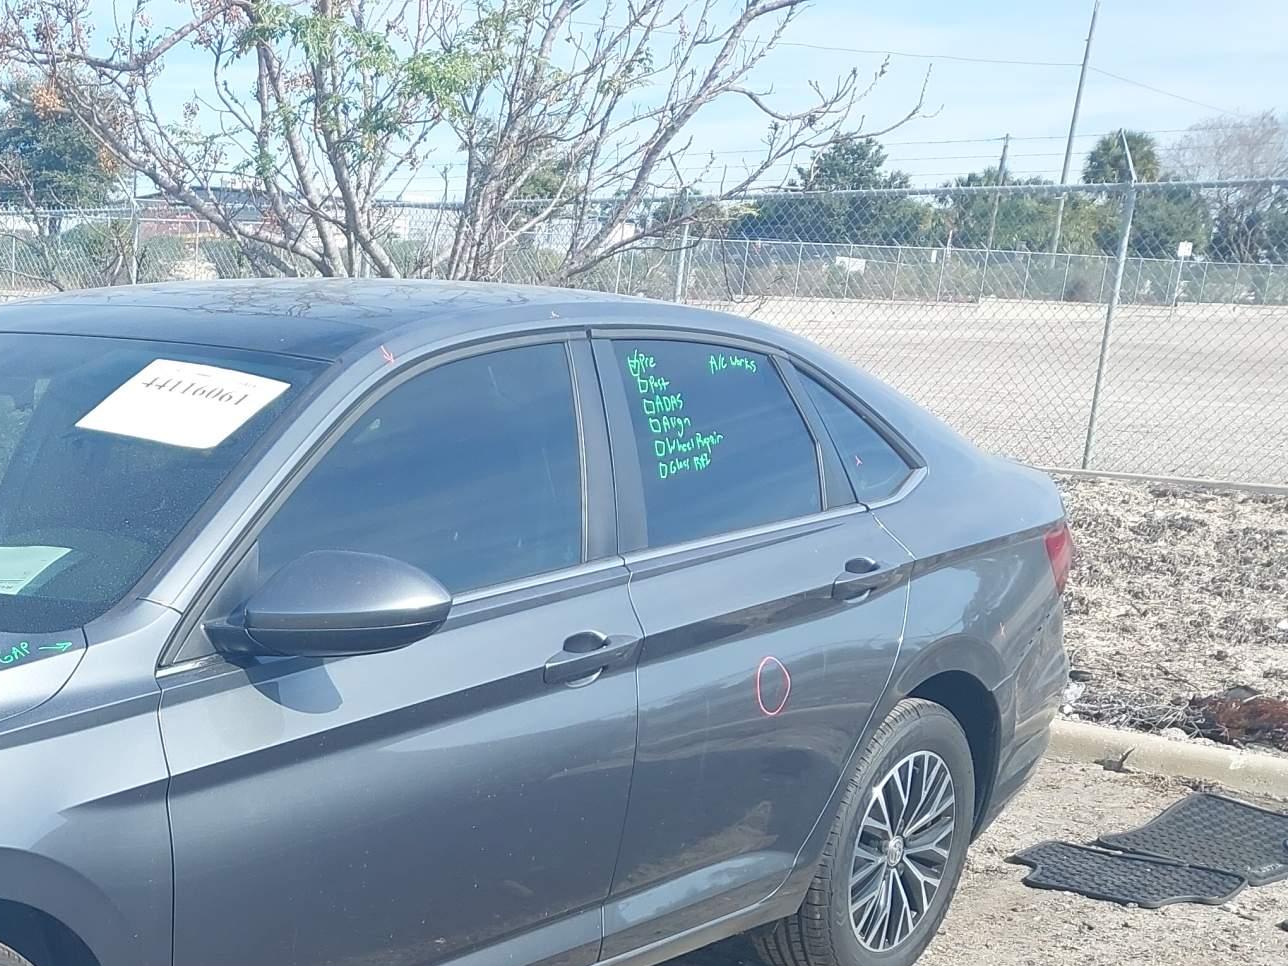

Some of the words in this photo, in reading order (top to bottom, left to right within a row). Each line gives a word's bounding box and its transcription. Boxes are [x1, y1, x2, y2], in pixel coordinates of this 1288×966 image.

[638, 353, 656, 373] Pre
[709, 353, 727, 374] A/C
[141, 376, 249, 406] 44116061
[648, 375, 670, 394] Post
[655, 392, 683, 413] ADAS
[662, 415, 691, 438] Align
[665, 436, 694, 454] Wheel
